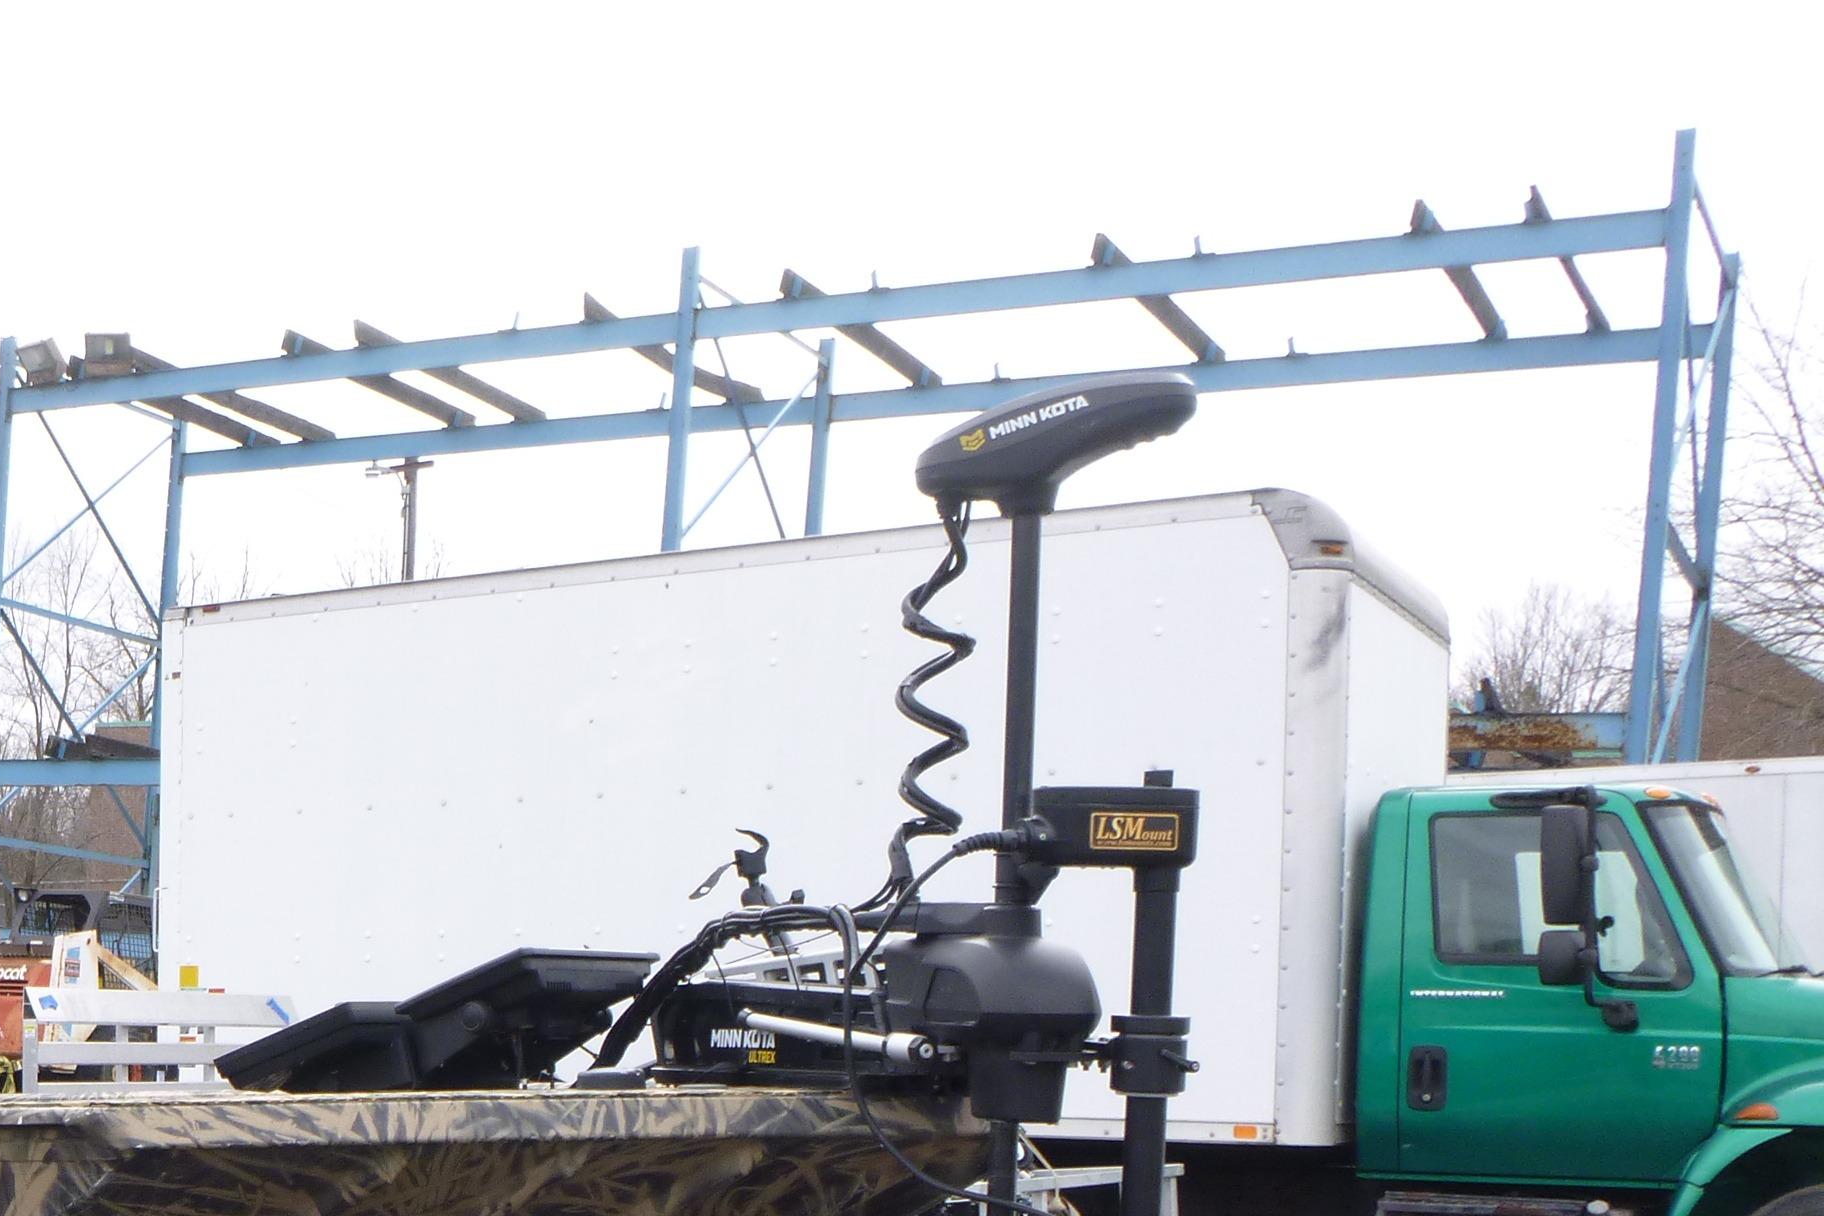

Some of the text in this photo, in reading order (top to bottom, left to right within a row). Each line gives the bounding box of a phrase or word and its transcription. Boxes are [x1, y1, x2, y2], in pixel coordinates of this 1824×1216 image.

[988, 395, 1089, 440] MINN KOTA
[710, 1028, 776, 1049] MINN KOTA
